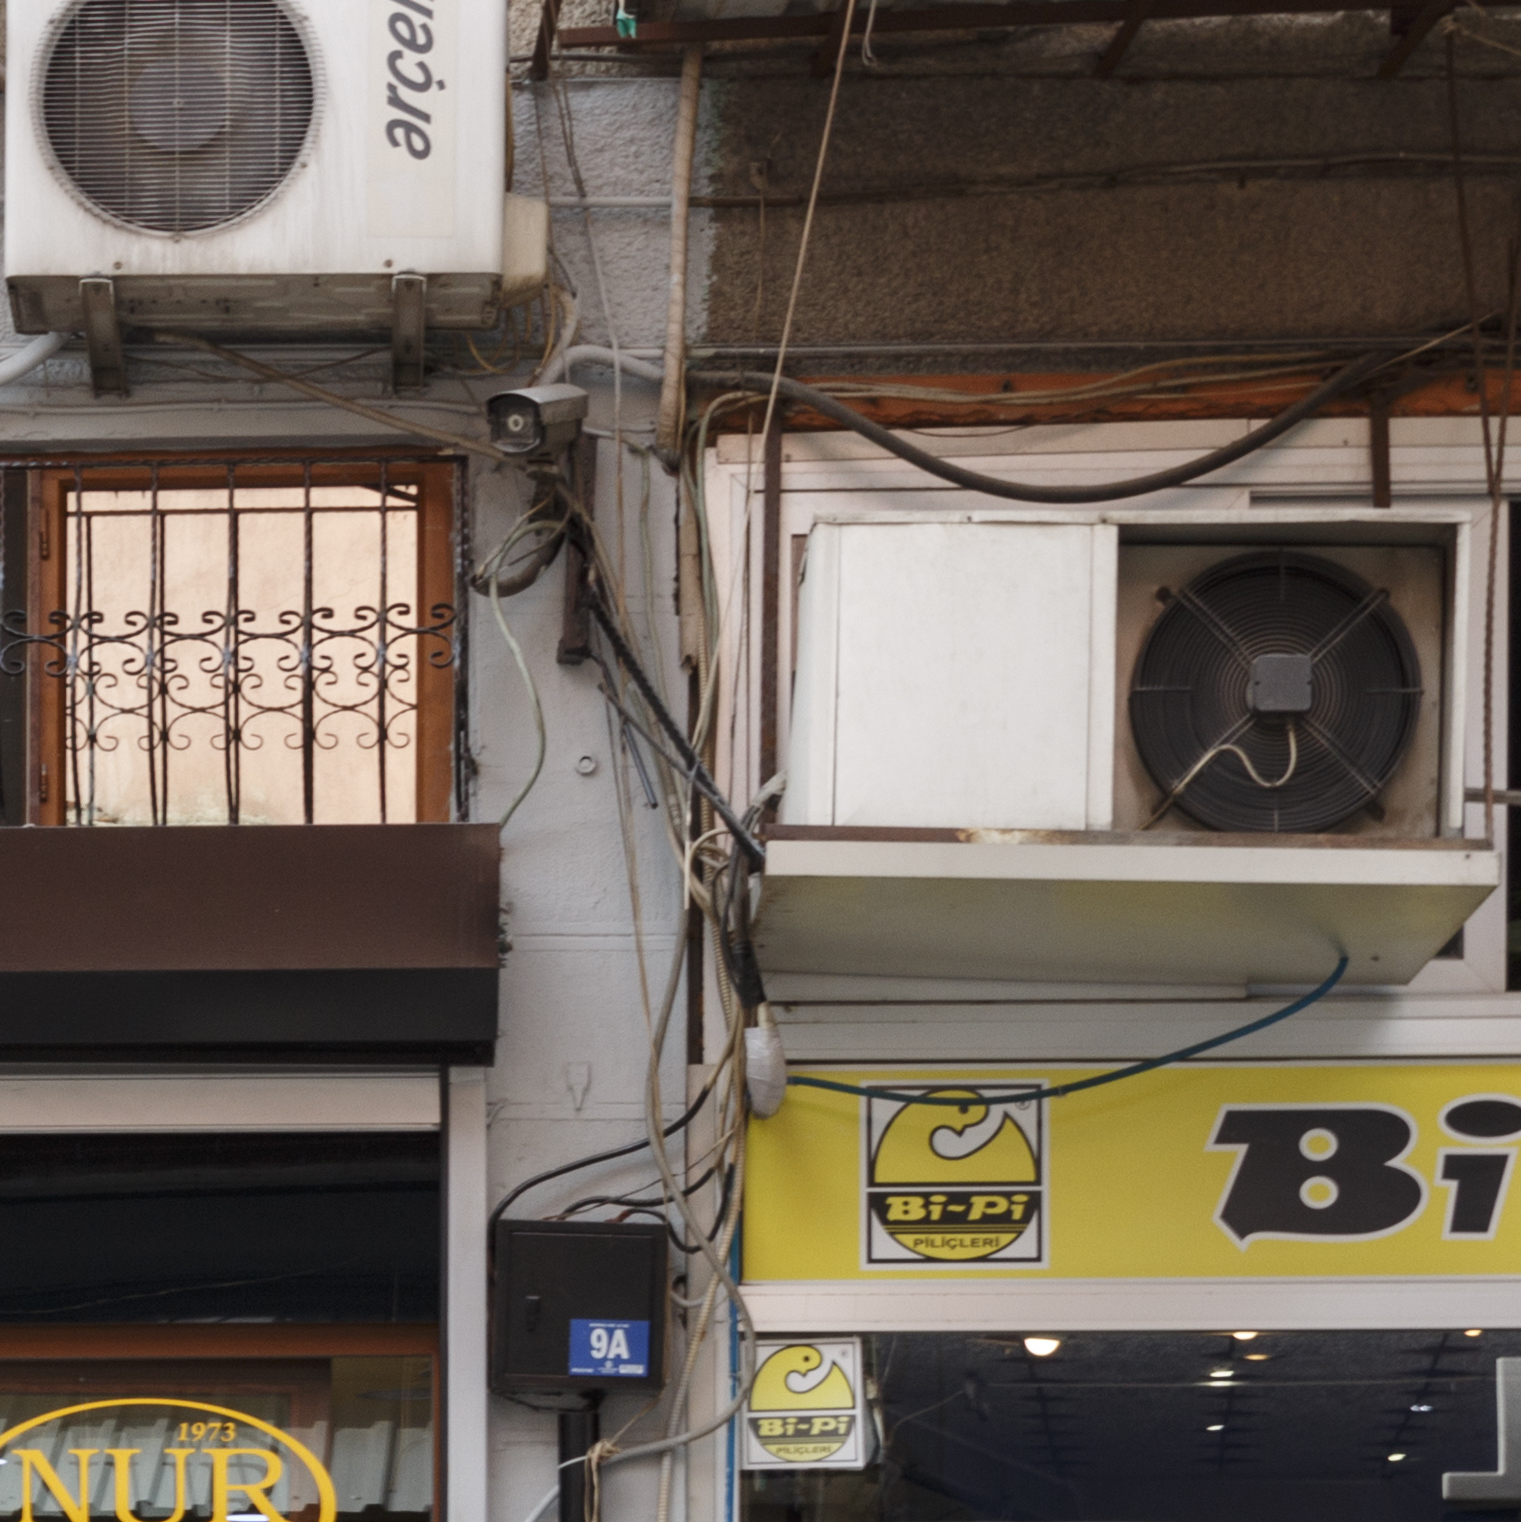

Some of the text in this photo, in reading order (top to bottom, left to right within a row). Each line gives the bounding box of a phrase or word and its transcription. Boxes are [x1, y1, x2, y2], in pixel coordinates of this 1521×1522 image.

[884, 1193, 1031, 1222] Bi-Pi
[912, 1234, 1001, 1251] PİLİÇLERİ
[589, 1327, 631, 1360] 9A
[177, 1421, 237, 1445] 1973
[757, 1415, 852, 1437] Bi-Pi
